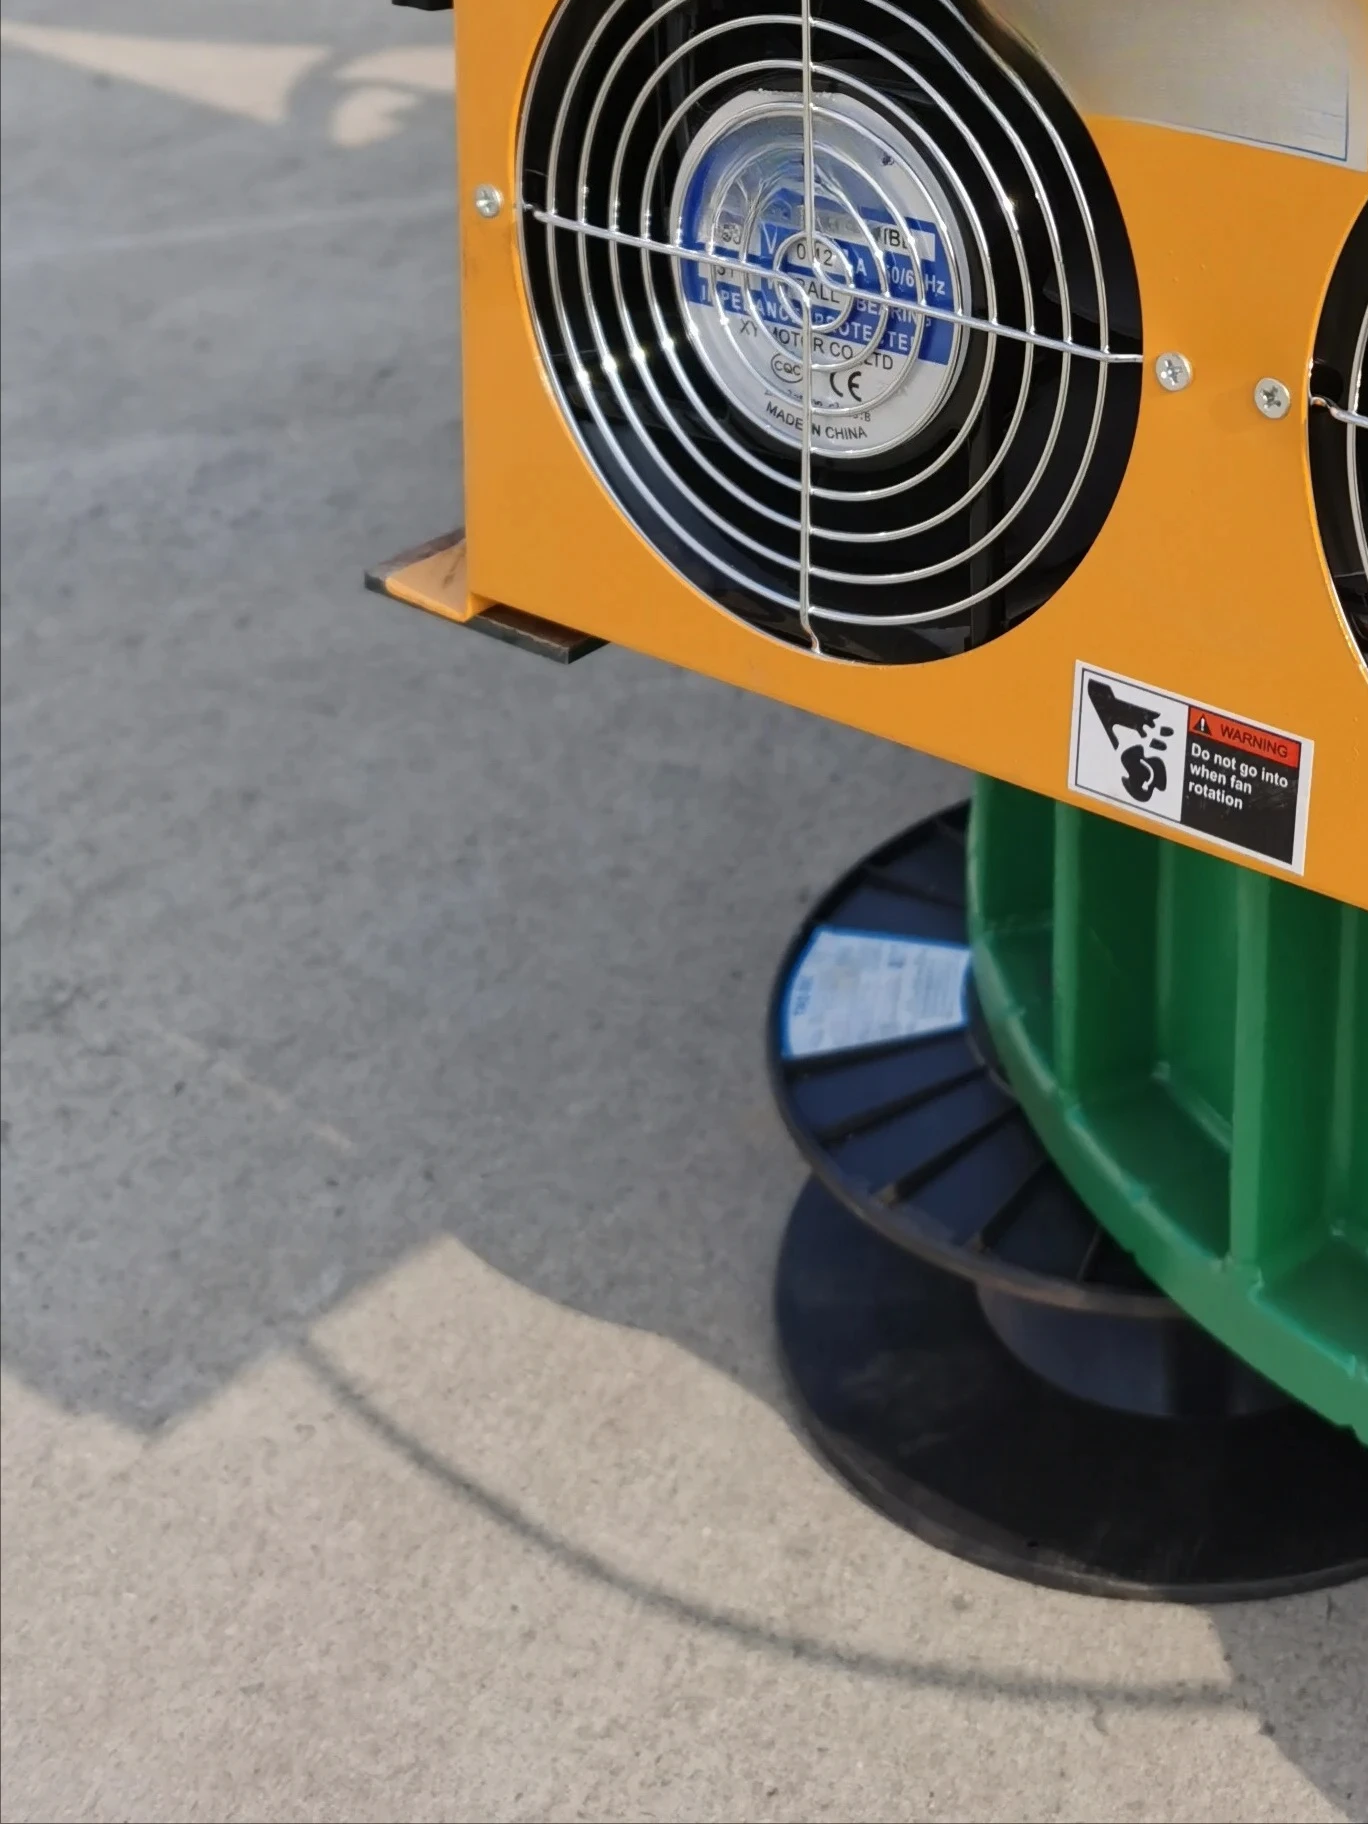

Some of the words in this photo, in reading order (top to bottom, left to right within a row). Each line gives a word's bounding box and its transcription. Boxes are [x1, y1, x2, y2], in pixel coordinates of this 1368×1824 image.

[829, 370, 862, 402] CE
[766, 401, 804, 432] MADE
[825, 426, 867, 440] CHINA
[1220, 723, 1289, 759] WARNING
[1189, 762, 1227, 787] when
[1230, 774, 1253, 796] fan
[1190, 742, 1210, 762] Do
[1213, 754, 1237, 771] not
[1239, 763, 1258, 779] go
[1261, 767, 1289, 789] into
[1188, 780, 1244, 811] rotation
